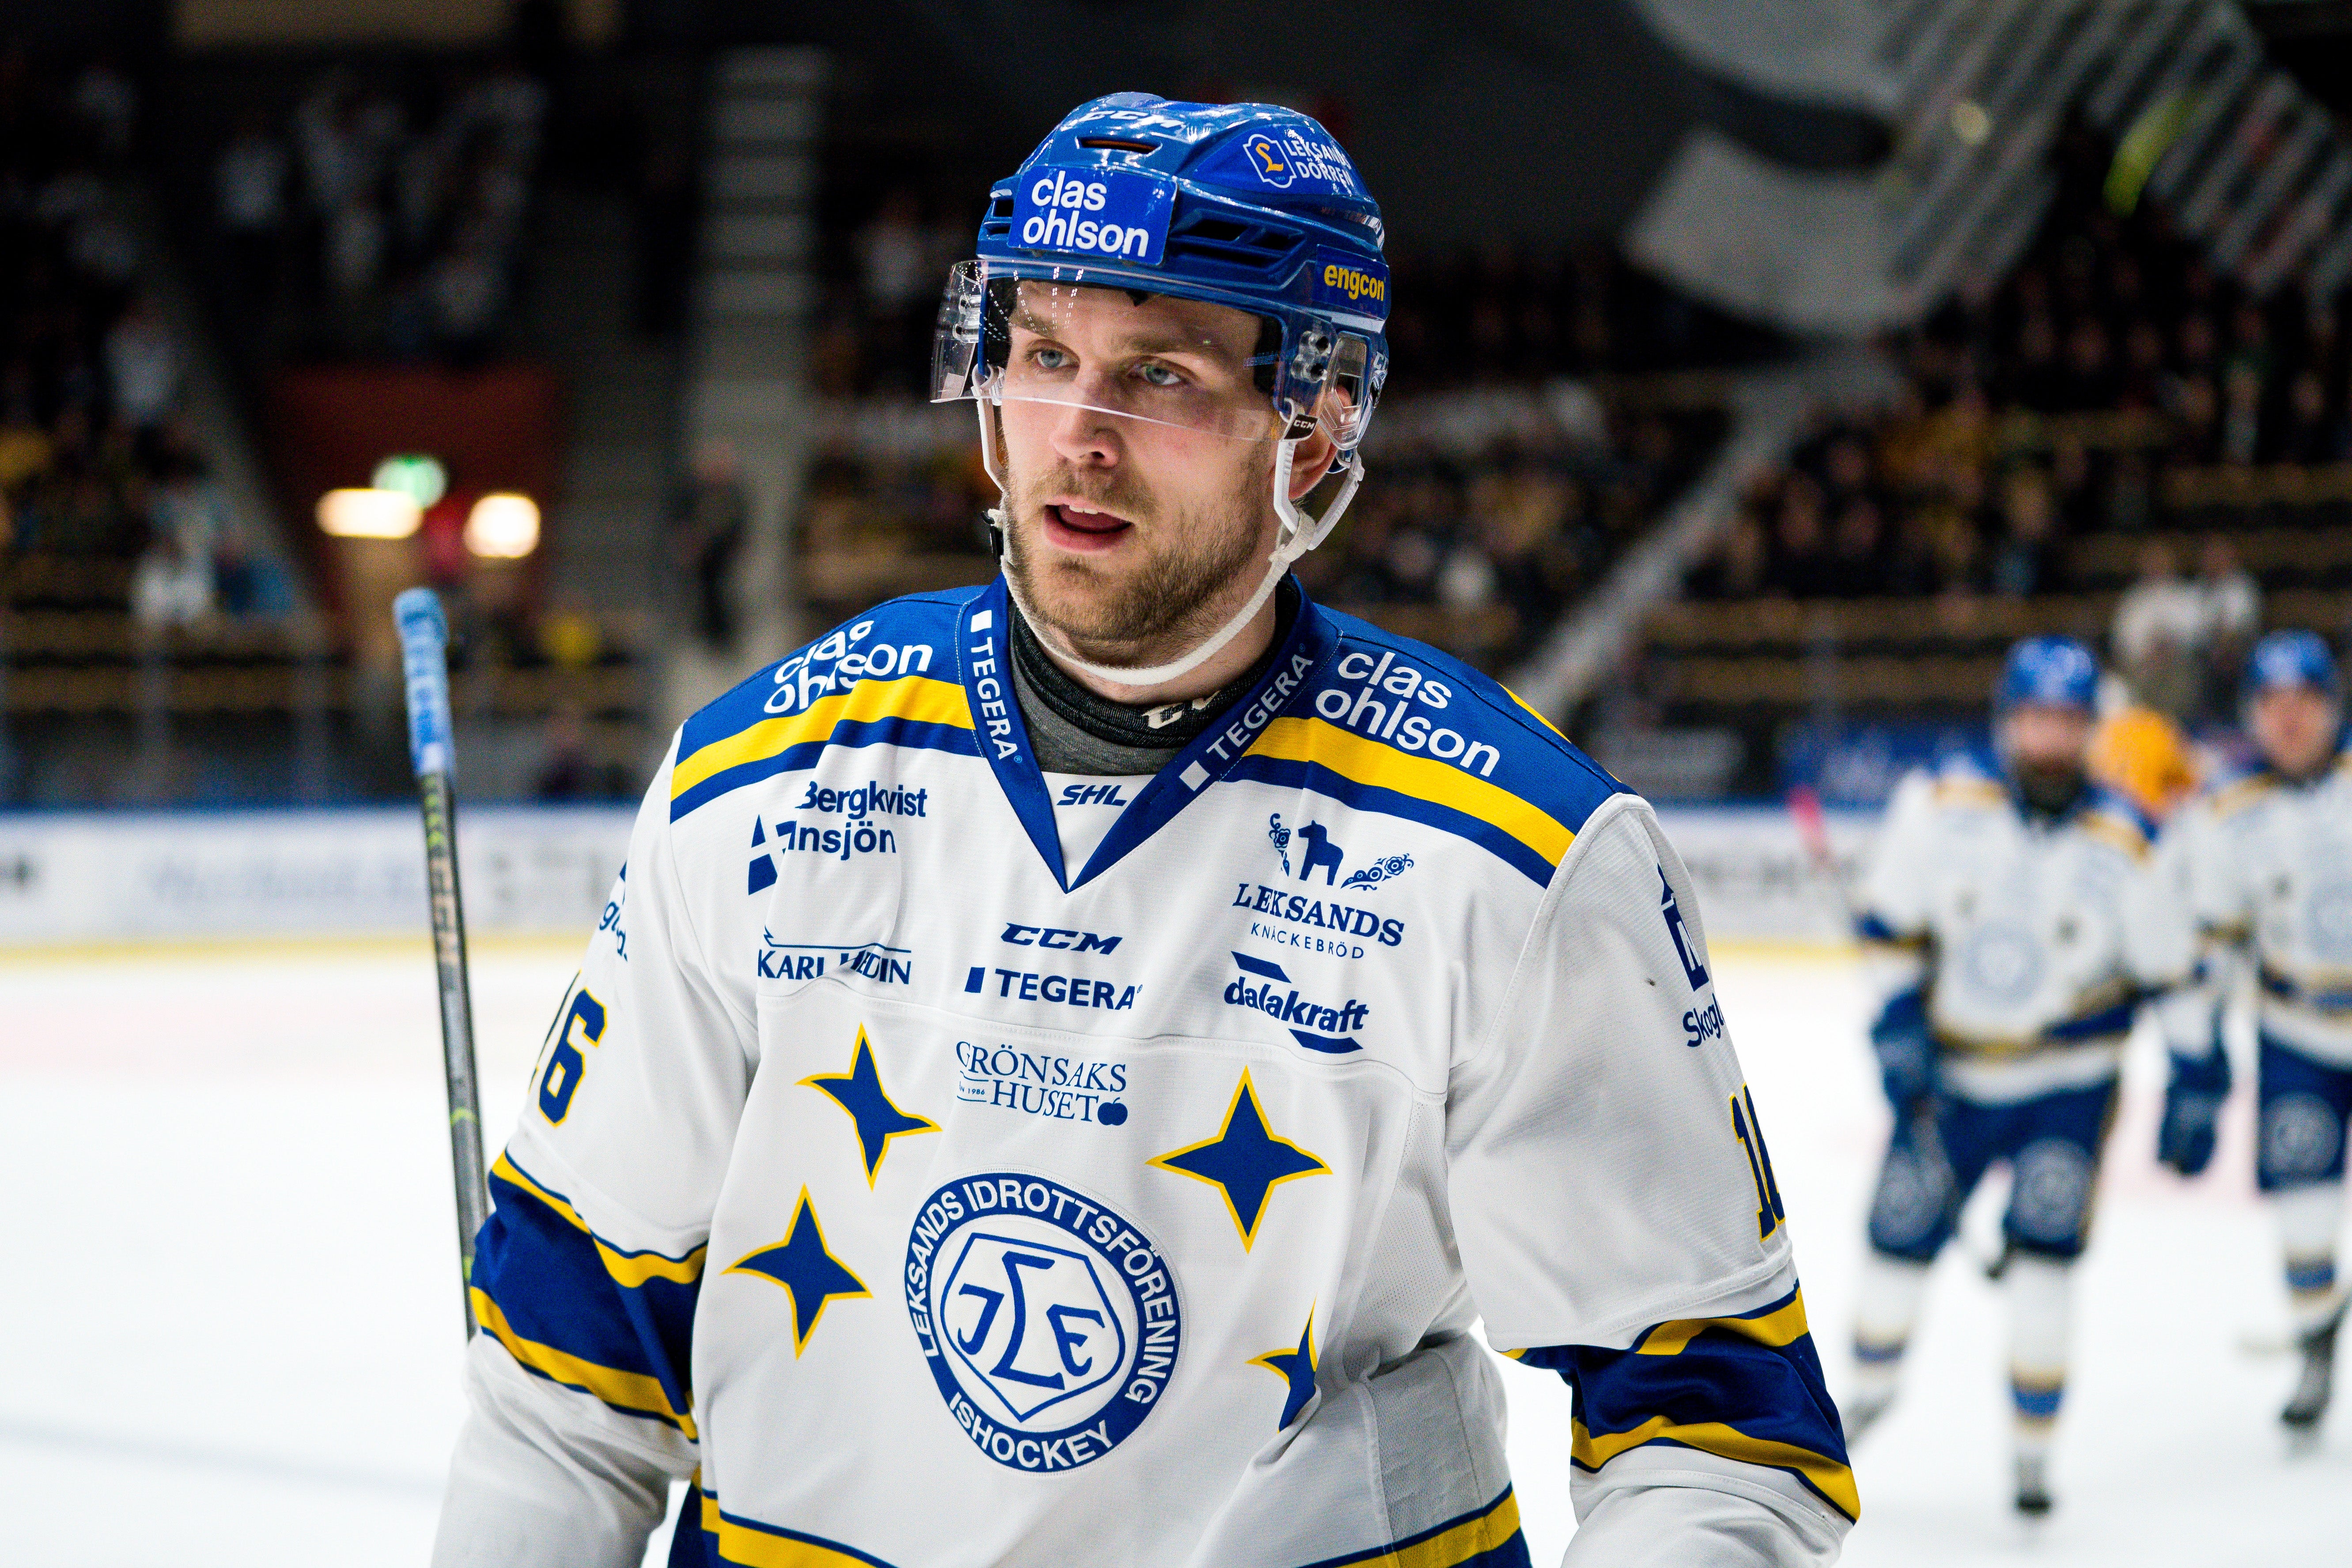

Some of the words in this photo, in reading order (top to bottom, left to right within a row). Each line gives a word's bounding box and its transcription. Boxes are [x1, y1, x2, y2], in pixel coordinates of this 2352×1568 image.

[1031, 170, 1107, 211] clas
[1295, 158, 1354, 187] DÖRREN
[1023, 209, 1149, 257] ohlson
[1324, 265, 1384, 301] engcon
[1293, 419, 1315, 430] CCM
[972, 637, 1017, 759] TEGERA
[1337, 651, 1452, 709] clas
[1206, 651, 1314, 761] TEGERA
[1315, 688, 1501, 777] ohlson
[795, 781, 927, 820] Bergkvist
[1056, 784, 1127, 806] SHL
[1000, 922, 1123, 955] CCM
[1232, 883, 1405, 947] LEKSANDS
[1251, 922, 1364, 959] KNÄCKEBRÖD
[995, 968, 1135, 1010] TEGERA
[1224, 977, 1369, 1033] dalakraft
[529, 969, 607, 1128] 6
[956, 1041, 1127, 1092] GRÖNSAKS
[990, 1079, 1099, 1122] HUSET
[905, 1192, 965, 1358] LEKSANDS
[962, 1179, 1176, 1405] IDROTTSFÖRENING
[949, 1392, 1113, 1469] ISHOCKEY
